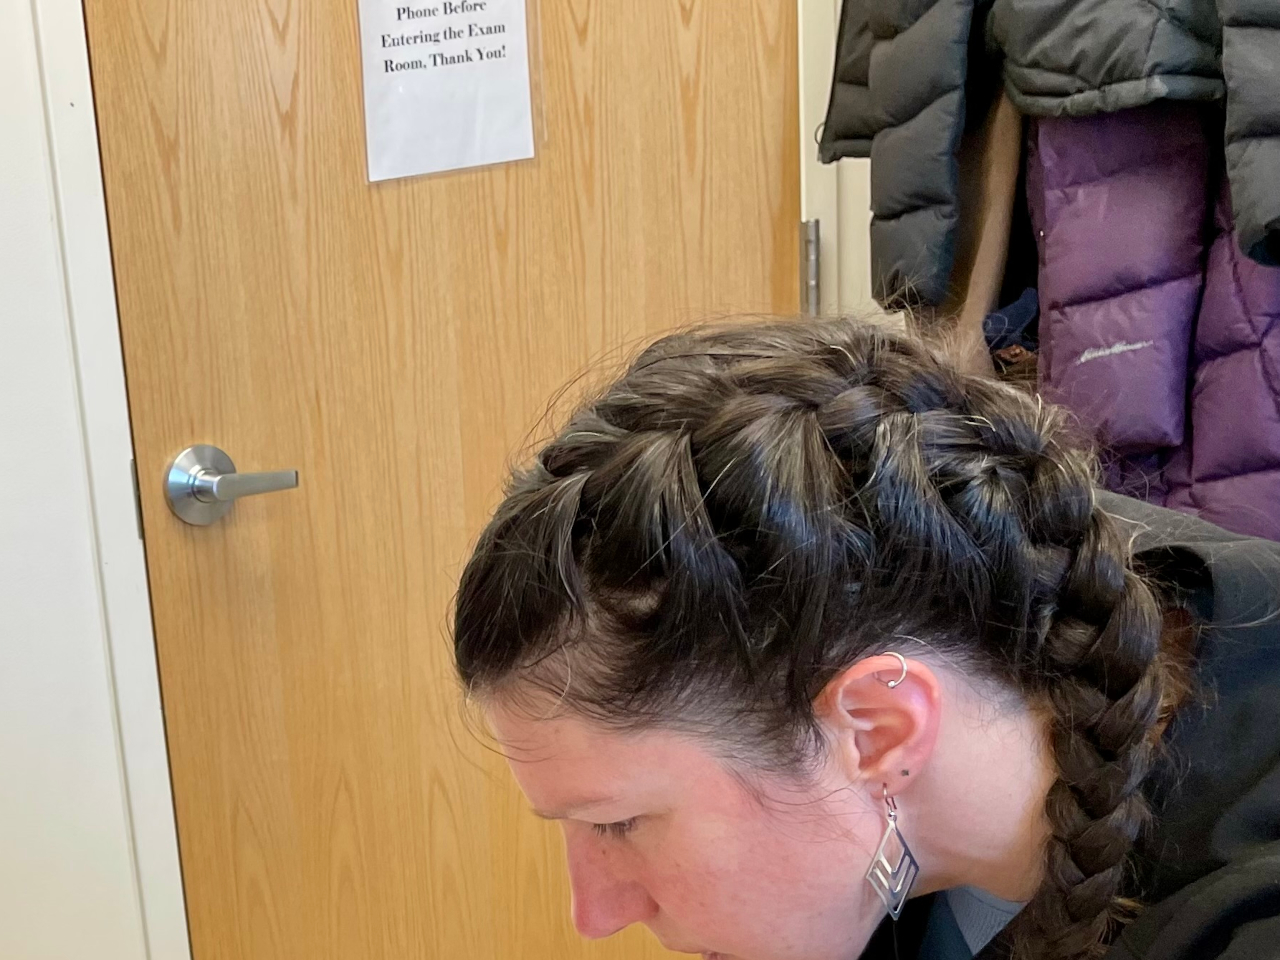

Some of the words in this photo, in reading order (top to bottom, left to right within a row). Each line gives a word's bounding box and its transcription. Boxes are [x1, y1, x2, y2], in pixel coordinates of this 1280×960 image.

[396, 6, 439, 21] Phone
[443, 0, 487, 15] Before
[381, 30, 441, 47] Entering
[443, 26, 464, 40] the
[468, 23, 506, 37] Exam
[429, 49, 474, 67] Thank
[476, 44, 507, 61] You!
